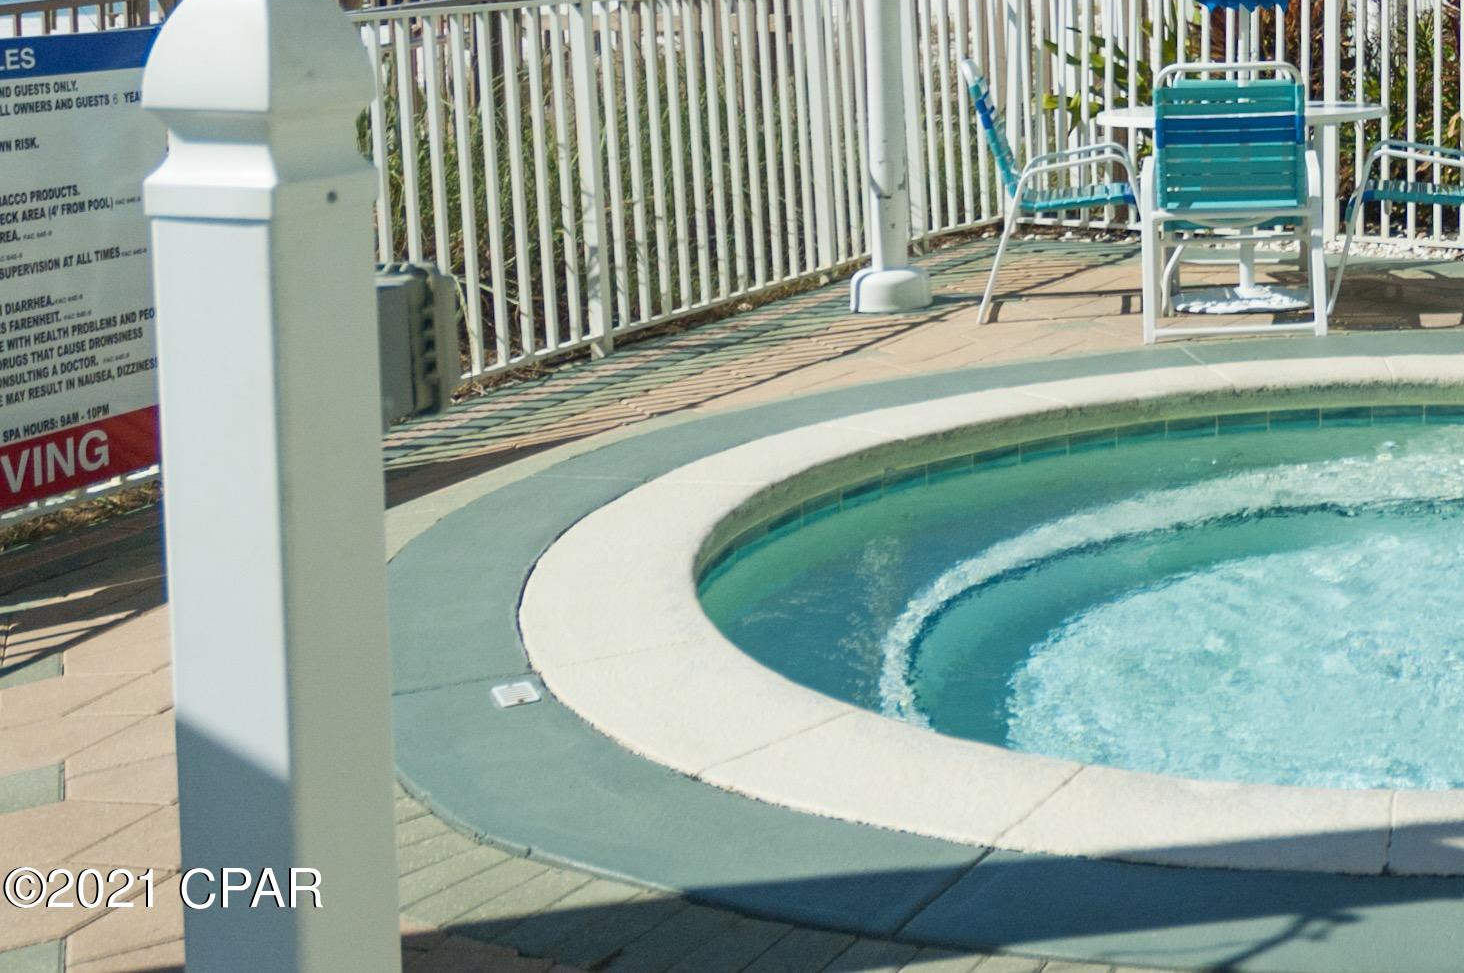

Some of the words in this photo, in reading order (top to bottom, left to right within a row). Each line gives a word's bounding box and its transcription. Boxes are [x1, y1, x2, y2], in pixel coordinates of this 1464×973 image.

[13, 100, 52, 115] OWNERS
[55, 97, 73, 111] AND
[76, 94, 110, 108] GUESTS
[113, 93, 119, 105] 6
[123, 90, 142, 103] YEA
[14, 82, 51, 97] GUESTS
[15, 137, 39, 151] RISK.
[30, 184, 80, 204] PRODUCTS.
[21, 208, 46, 223] AREA
[61, 202, 86, 216] FROM
[88, 197, 113, 212] POOL)
[0, 258, 61, 280] SUPERVISION
[63, 255, 74, 268] AT
[76, 252, 92, 266] ALL
[94, 246, 120, 262] TIMES
[5, 294, 54, 316] DIARRHEA.
[7, 335, 31, 351] WITH
[34, 327, 69, 345] HEALTH
[71, 316, 117, 336] PROBLEMS
[120, 312, 137, 326] AND
[30, 348, 54, 364] THAT
[57, 341, 86, 357] CAUSE
[88, 327, 143, 350] DROWSINESS
[51, 365, 58, 377] A
[60, 355, 99, 373] DOCTOR.
[6, 390, 25, 406] MAY
[28, 381, 63, 400] RESULT
[66, 378, 76, 390] IN
[78, 369, 115, 386] NAUSEA,
[3, 428, 21, 442] SPA
[24, 417, 59, 437] HOURS:
[60, 412, 80, 427] 9AM
[87, 404, 110, 420] 10PM
[0, 429, 110, 494] VING
